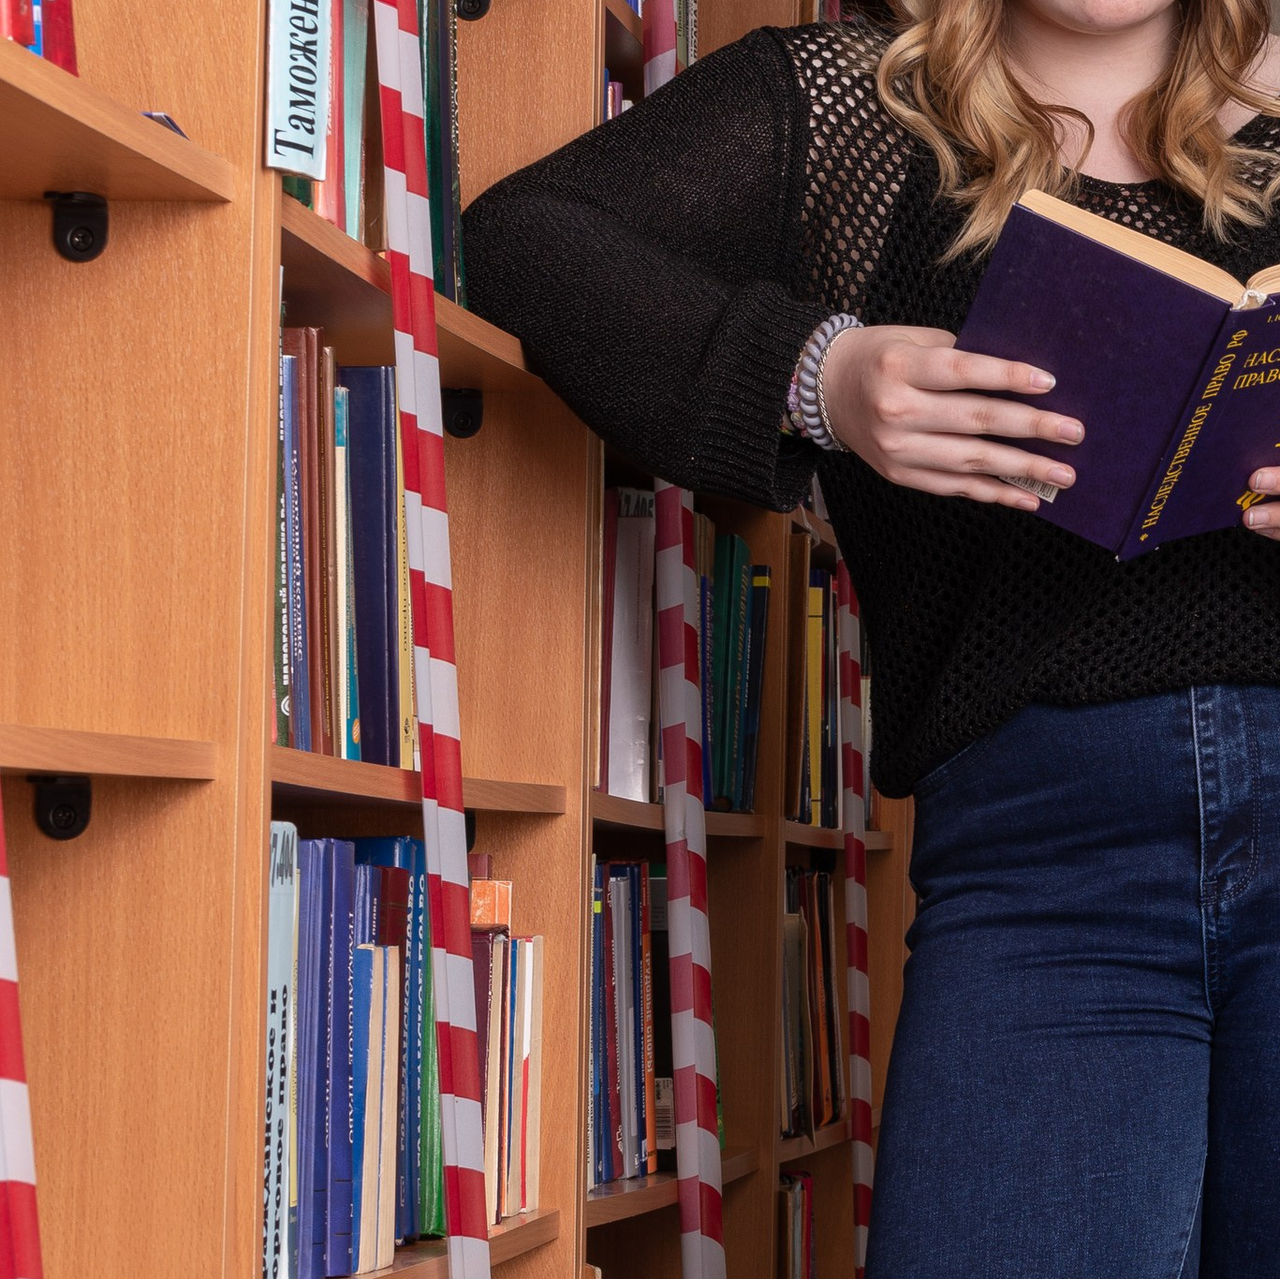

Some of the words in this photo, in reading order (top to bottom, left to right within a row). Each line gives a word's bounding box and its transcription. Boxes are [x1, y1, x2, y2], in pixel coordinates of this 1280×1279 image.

[1142, 403, 1213, 530] НАСЛЕДСТВЕННОЕ
[1202, 353, 1237, 400] ПРАВО
[1226, 329, 1249, 350] РФ
[270, 830, 295, 888] 7.404
[405, 875, 415, 959] ПРАВО
[270, 988, 277, 1016] и
[644, 950, 652, 1021] ТРУДОВЫЕ
[279, 984, 287, 1107] право
